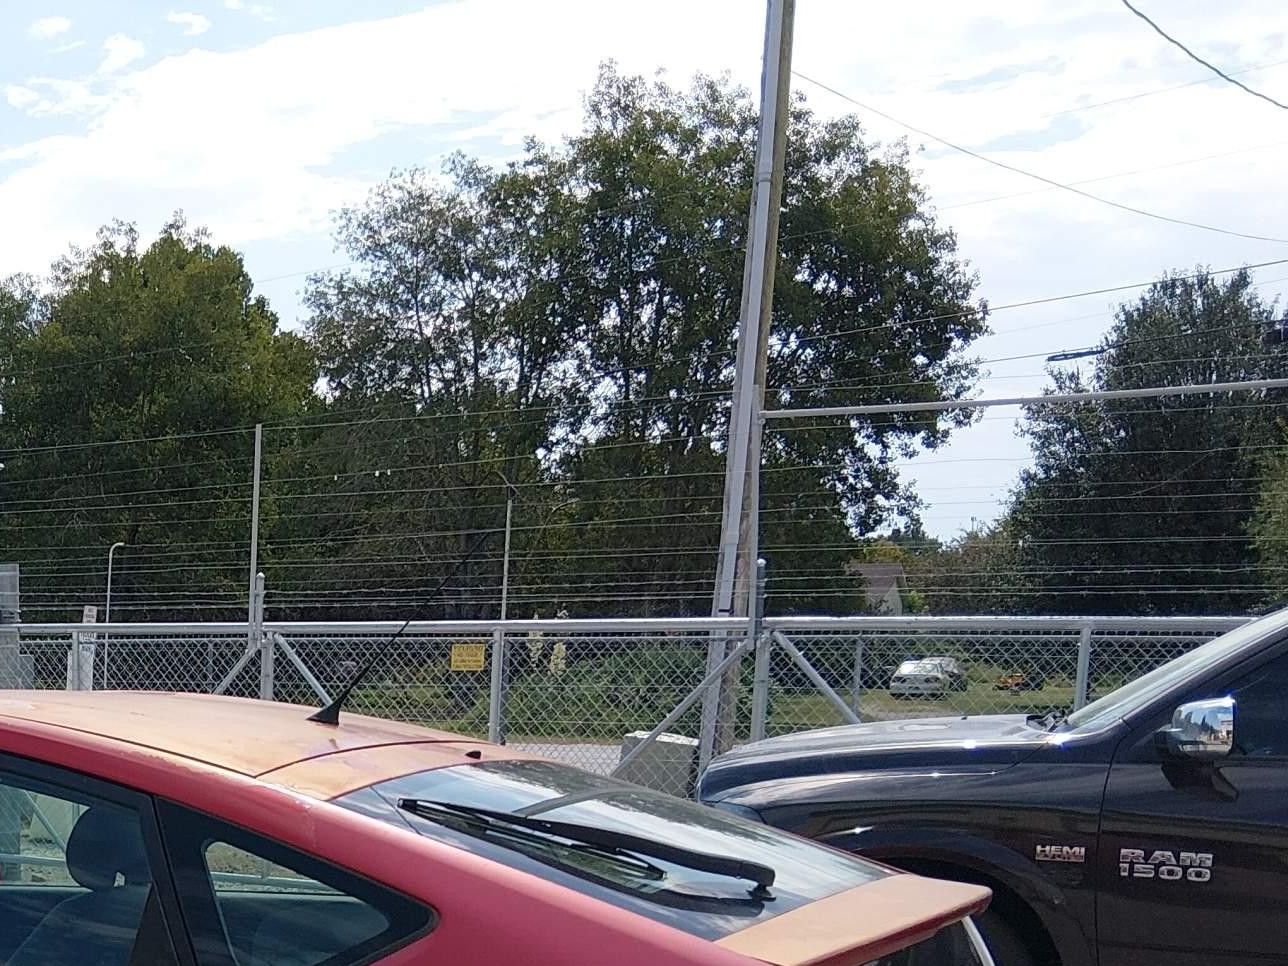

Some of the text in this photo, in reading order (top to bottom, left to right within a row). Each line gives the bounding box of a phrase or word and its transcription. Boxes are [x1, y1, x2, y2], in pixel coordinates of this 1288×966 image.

[1036, 845, 1086, 857] HEMI
[1119, 848, 1214, 867] RAM
[1119, 863, 1211, 882] 1500
